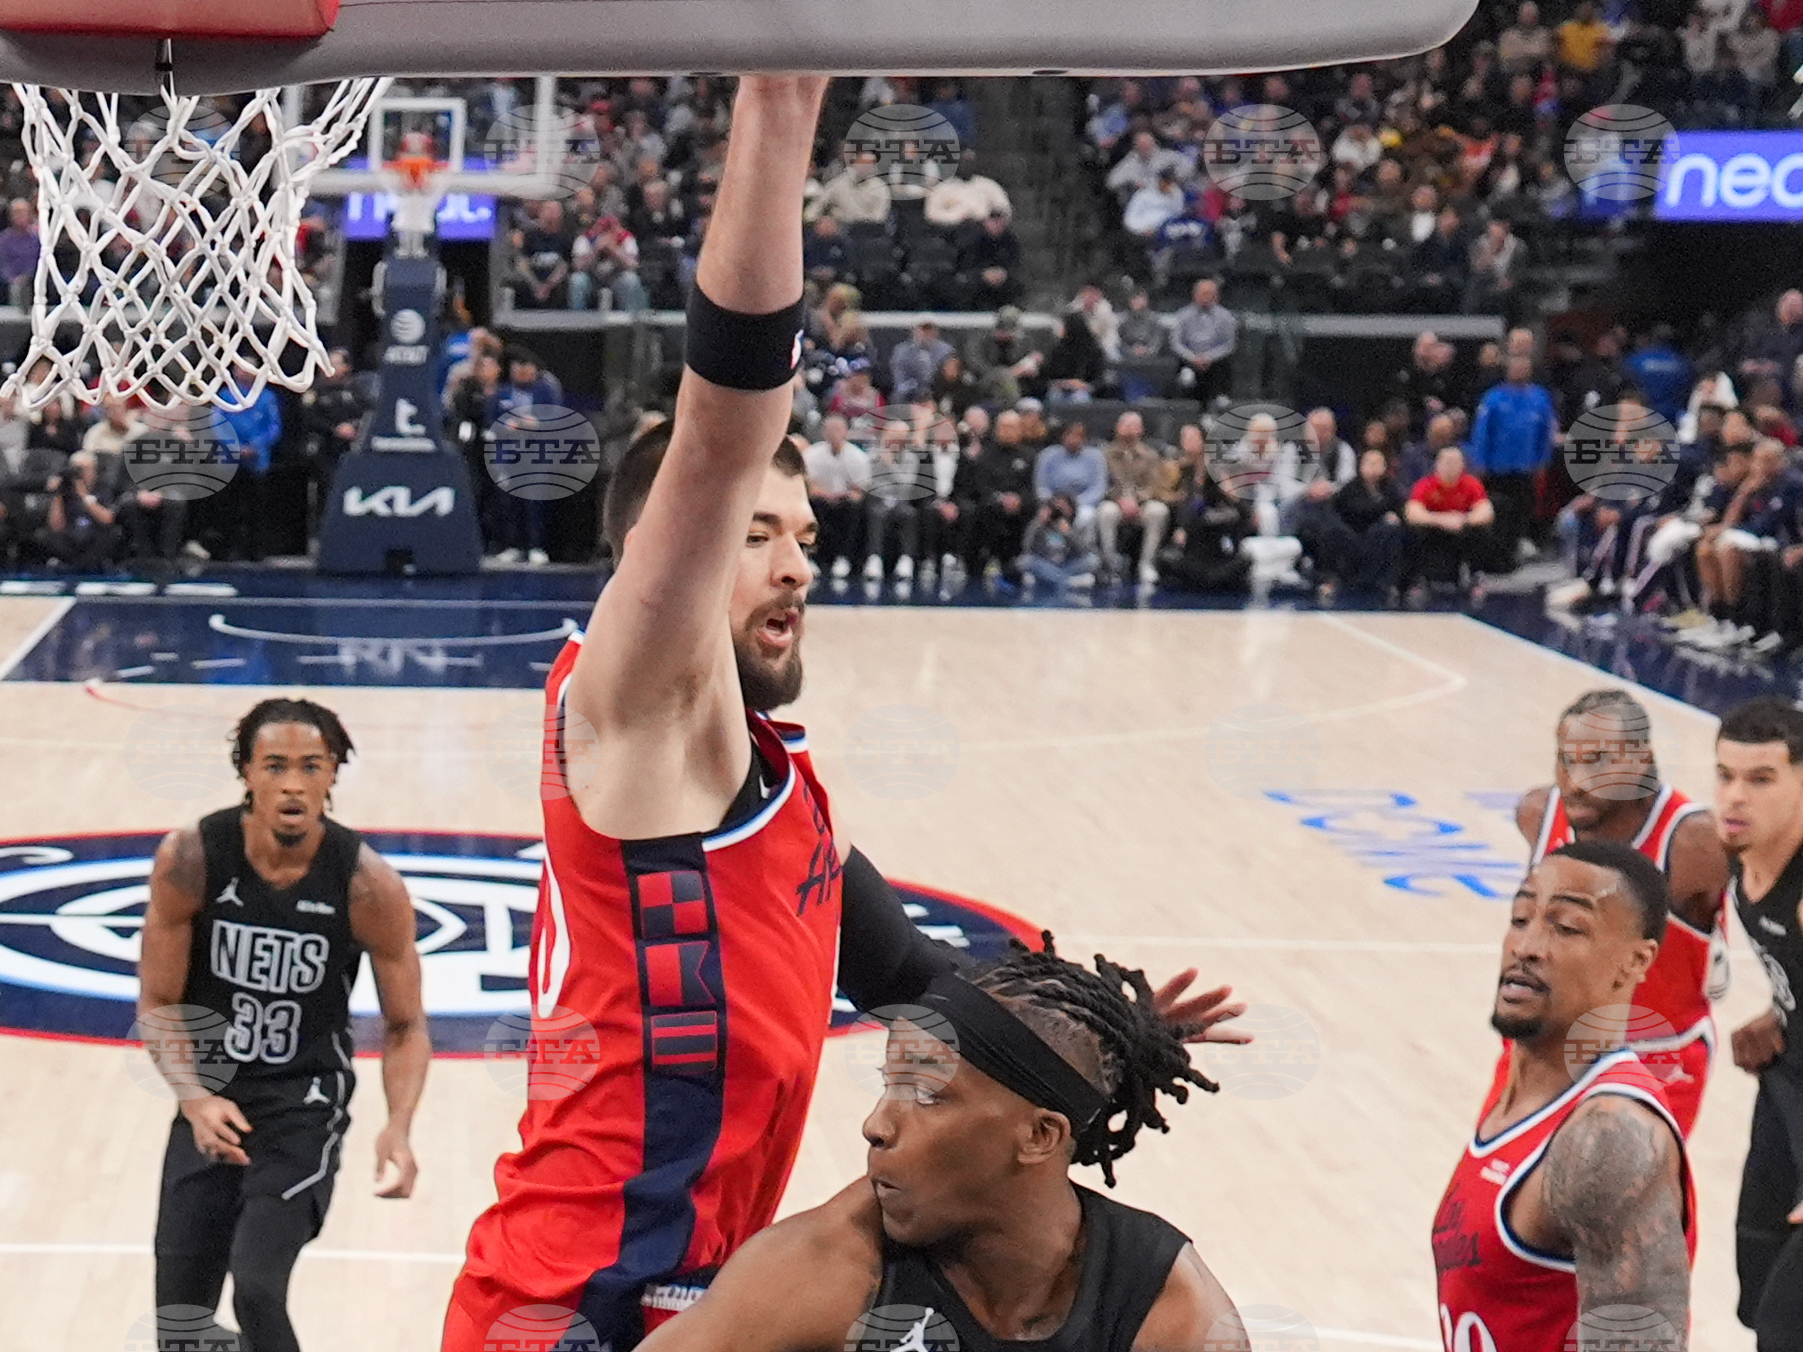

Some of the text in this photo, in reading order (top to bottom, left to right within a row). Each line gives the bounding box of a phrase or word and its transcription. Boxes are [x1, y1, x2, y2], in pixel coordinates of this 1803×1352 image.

[343, 486, 455, 517] KIA
[210, 919, 330, 994] NETS
[223, 991, 302, 1064] 33
